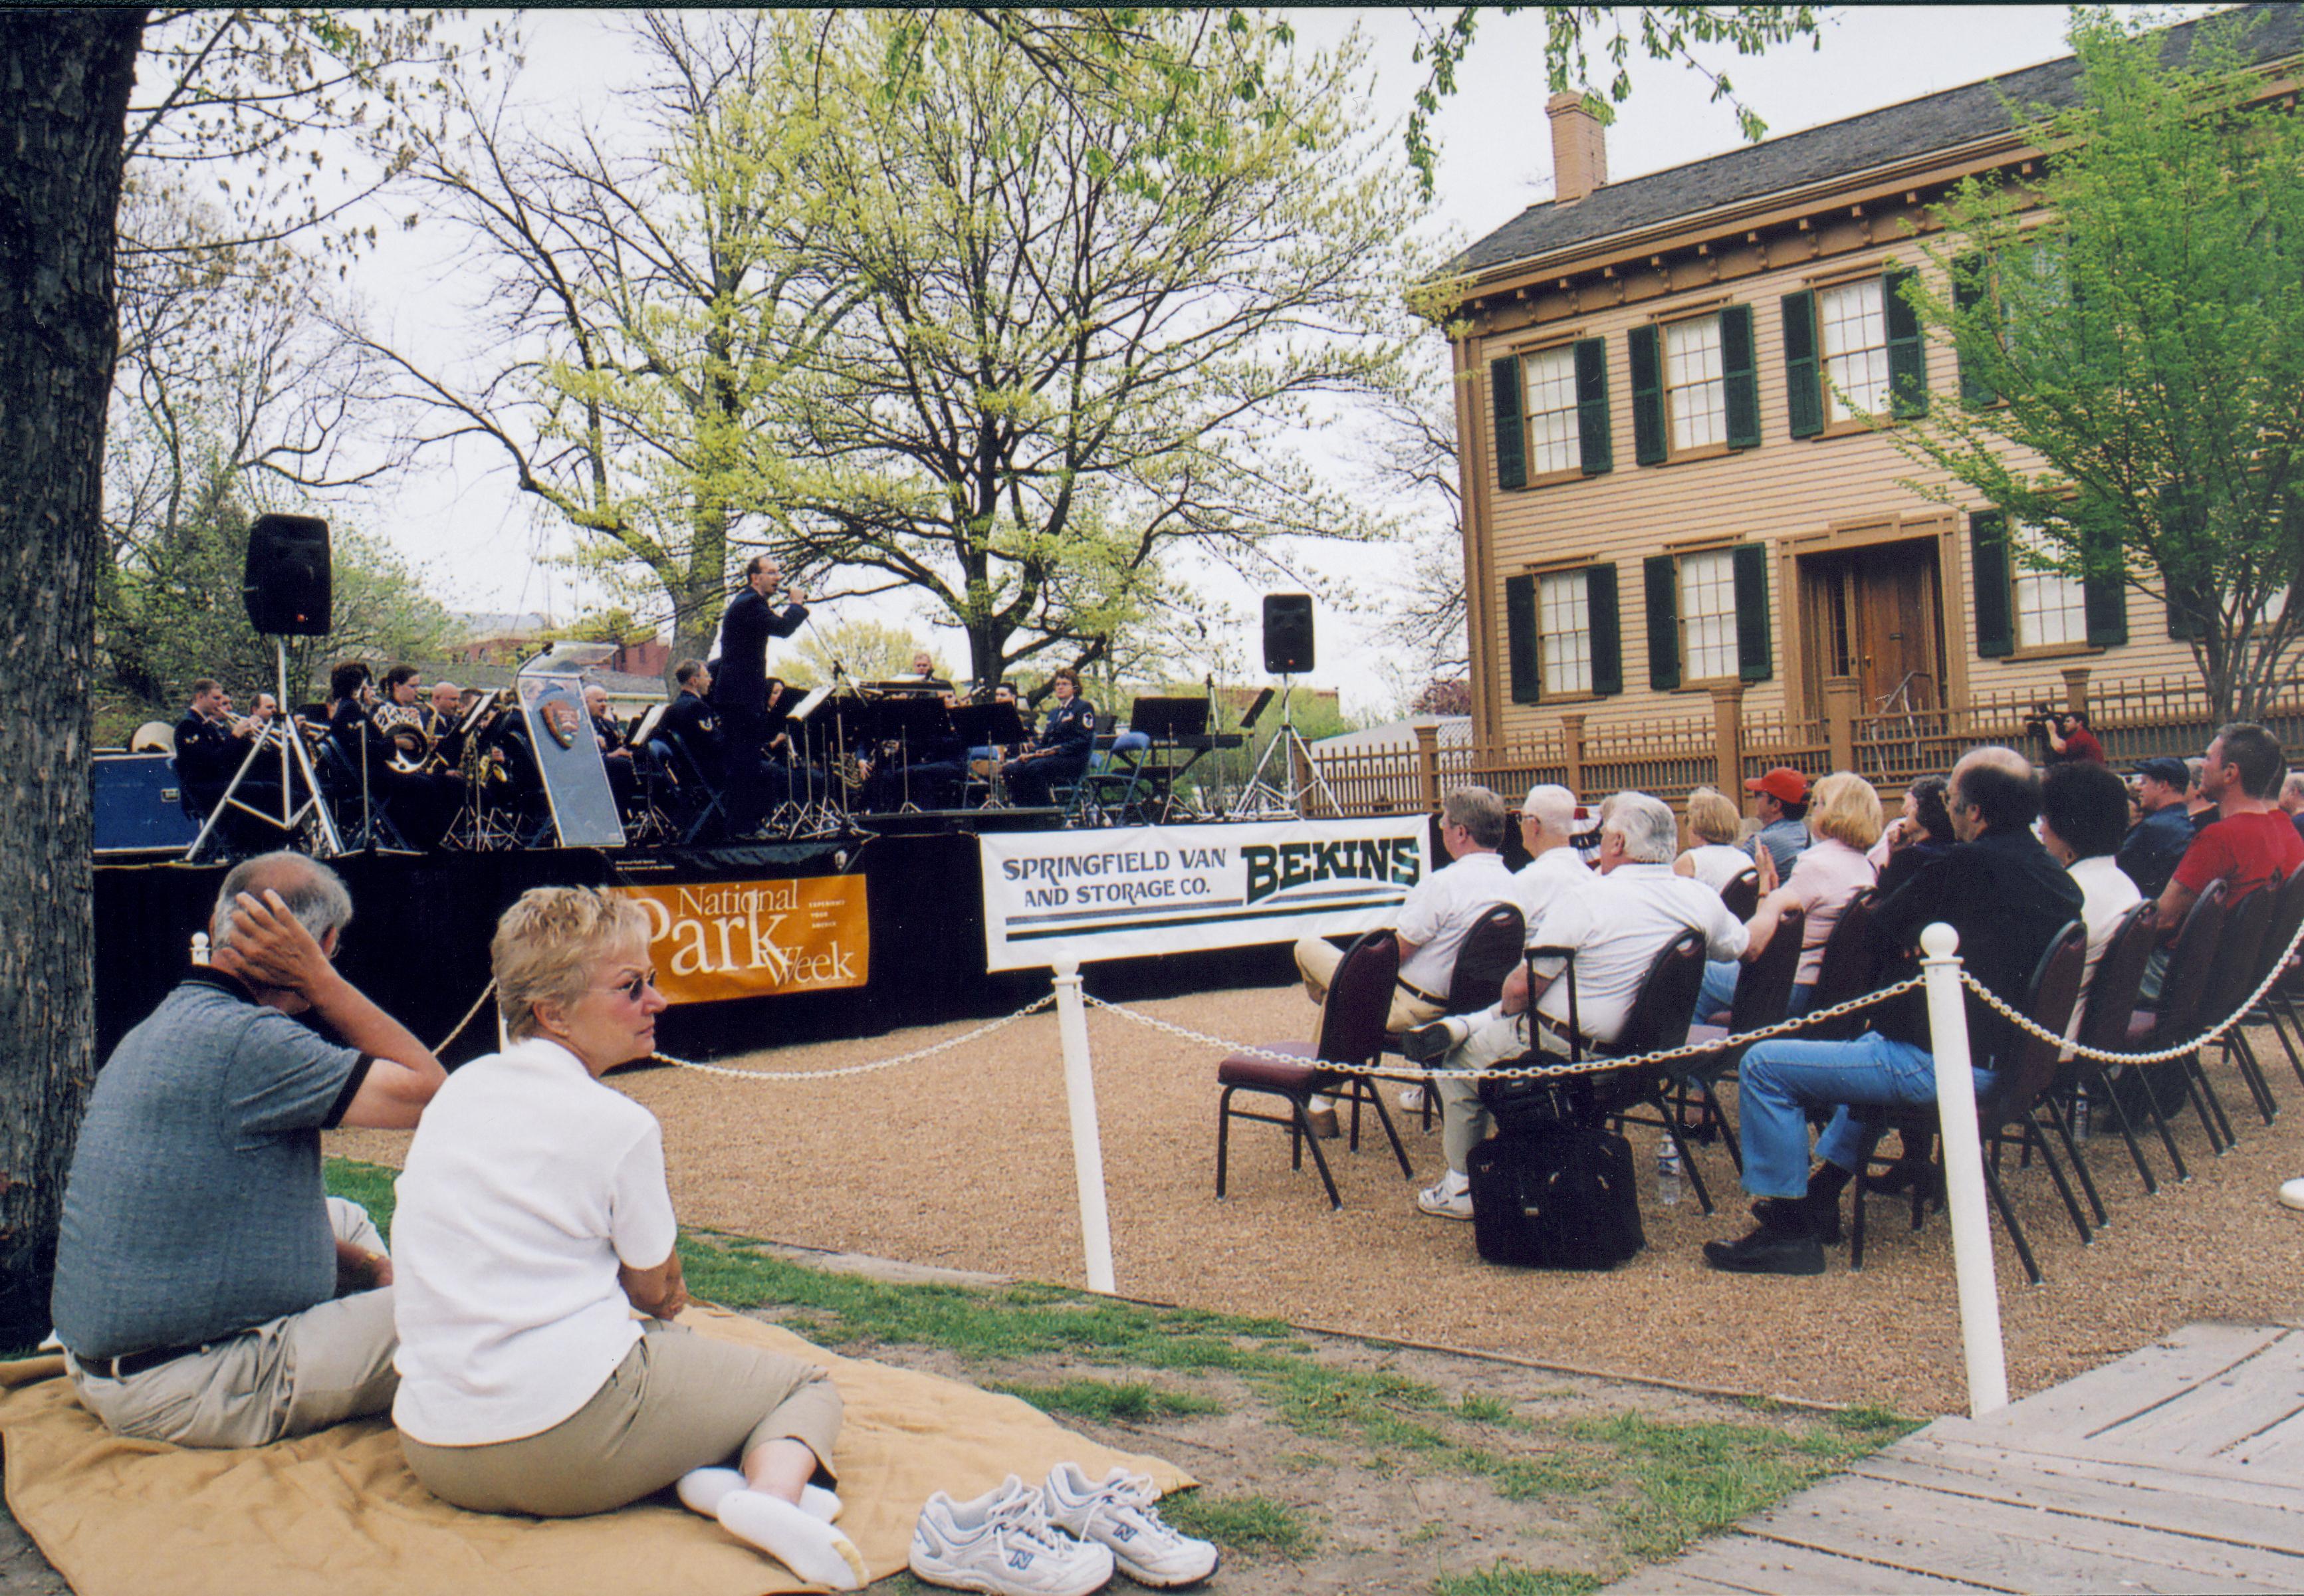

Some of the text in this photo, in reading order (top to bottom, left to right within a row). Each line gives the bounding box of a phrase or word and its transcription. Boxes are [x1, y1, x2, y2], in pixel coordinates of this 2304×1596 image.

[1002, 848, 1226, 886] SPRINGFIELD VAN
[1240, 836, 1420, 905] BEKINS
[677, 878, 799, 917] National
[1025, 877, 1211, 907] AND STORAGE CO.
[760, 941, 856, 987] Week
[1113, 1523, 1139, 1543] N
[1007, 1549, 1035, 1571] N
